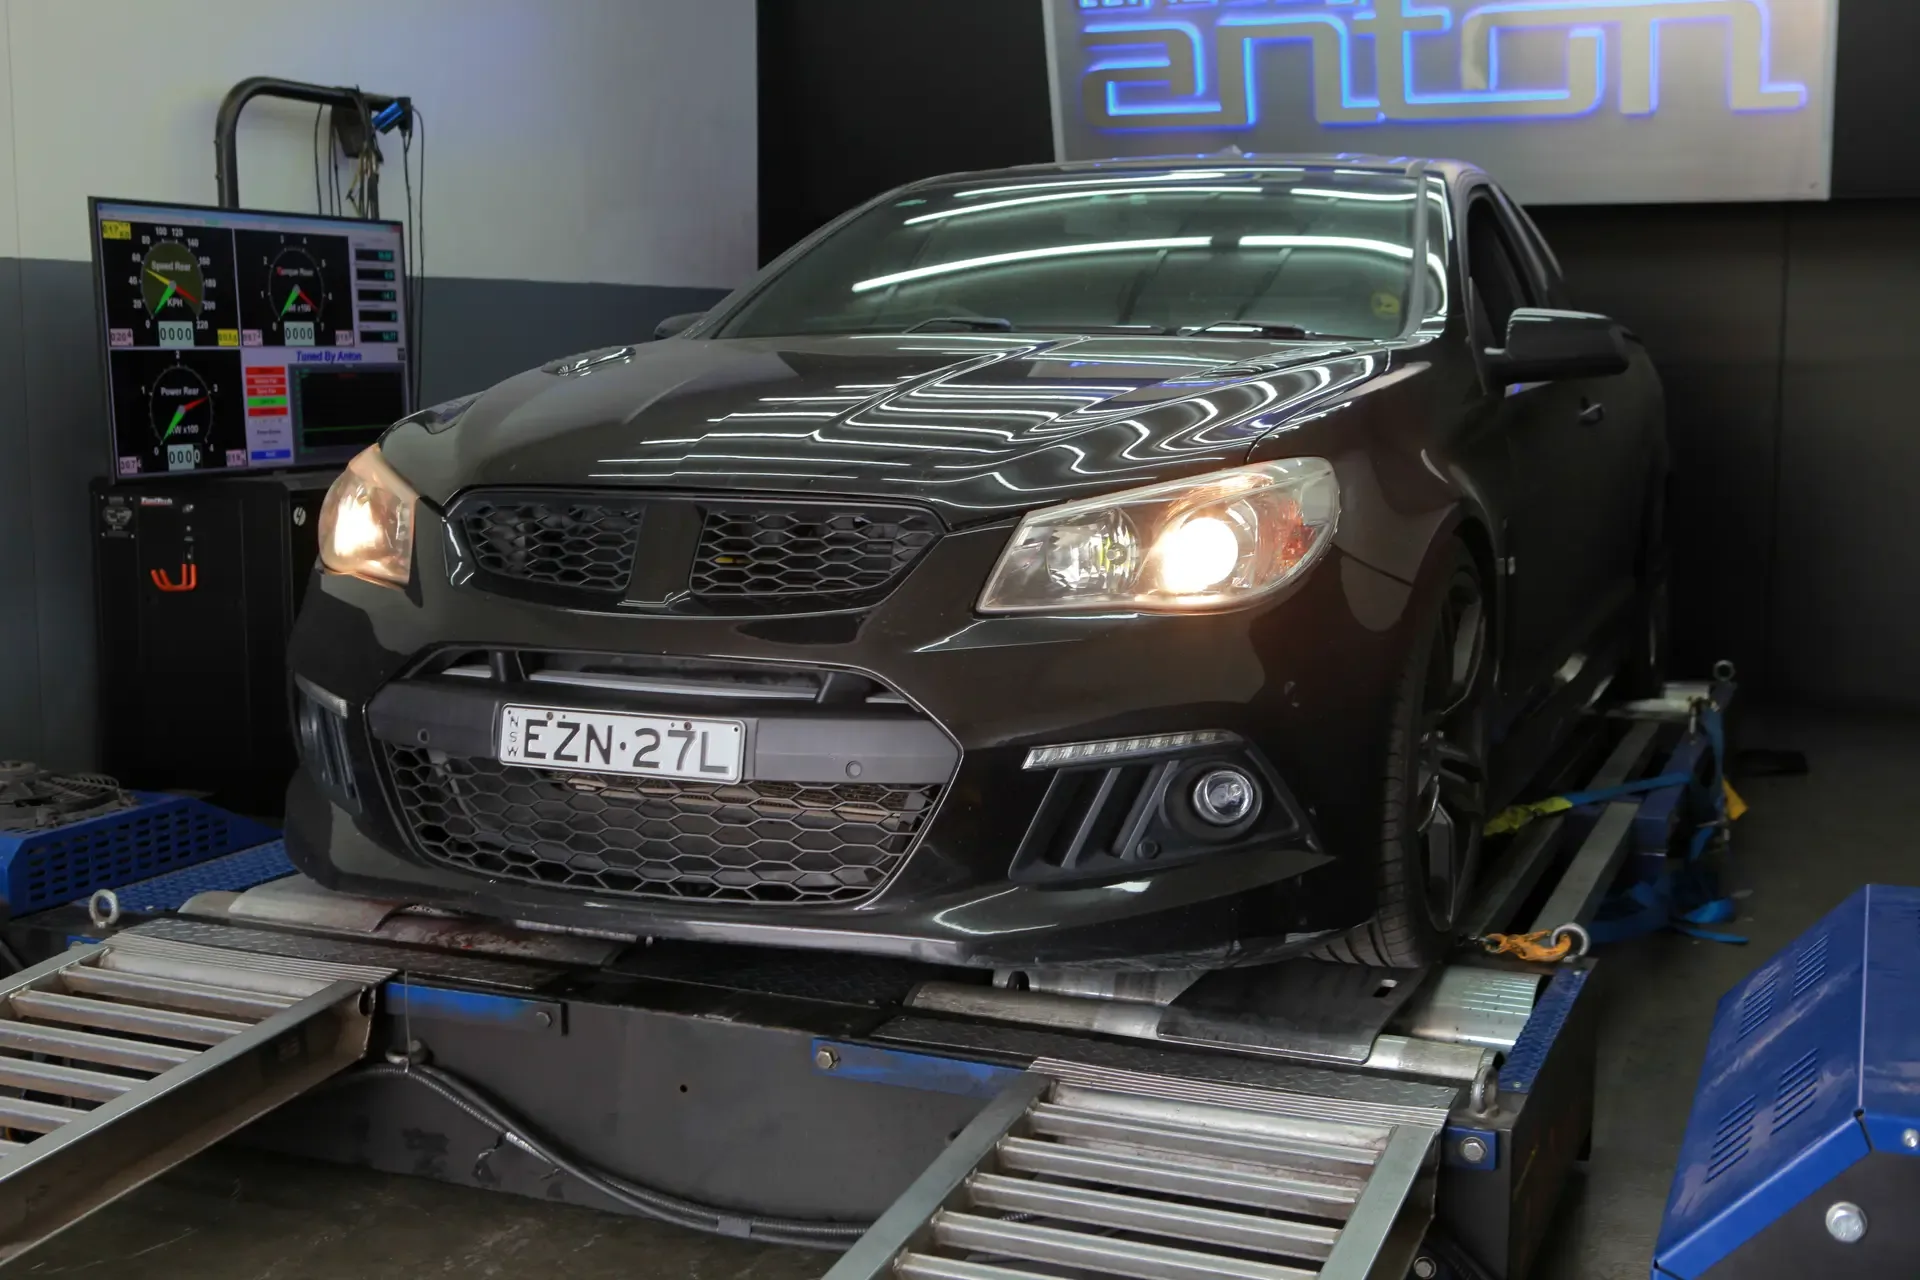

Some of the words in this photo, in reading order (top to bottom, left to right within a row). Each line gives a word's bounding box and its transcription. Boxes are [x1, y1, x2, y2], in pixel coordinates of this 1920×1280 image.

[1081, 0, 1807, 130] anton
[156, 226, 168, 236] 100
[172, 228, 184, 237] 120
[188, 238, 198, 248] 140
[152, 260, 174, 272] Speed
[174, 261, 190, 272] Rear
[128, 276, 138, 286] 40
[167, 298, 184, 308] KPH
[160, 327, 192, 340] 0000
[285, 328, 314, 340] 0000
[296, 351, 322, 362] Tuned
[324, 351, 336, 364] By
[337, 351, 362, 362] Anton
[160, 386, 182, 396] Power
[184, 386, 200, 396] Rear
[507, 715, 519, 757] NSW
